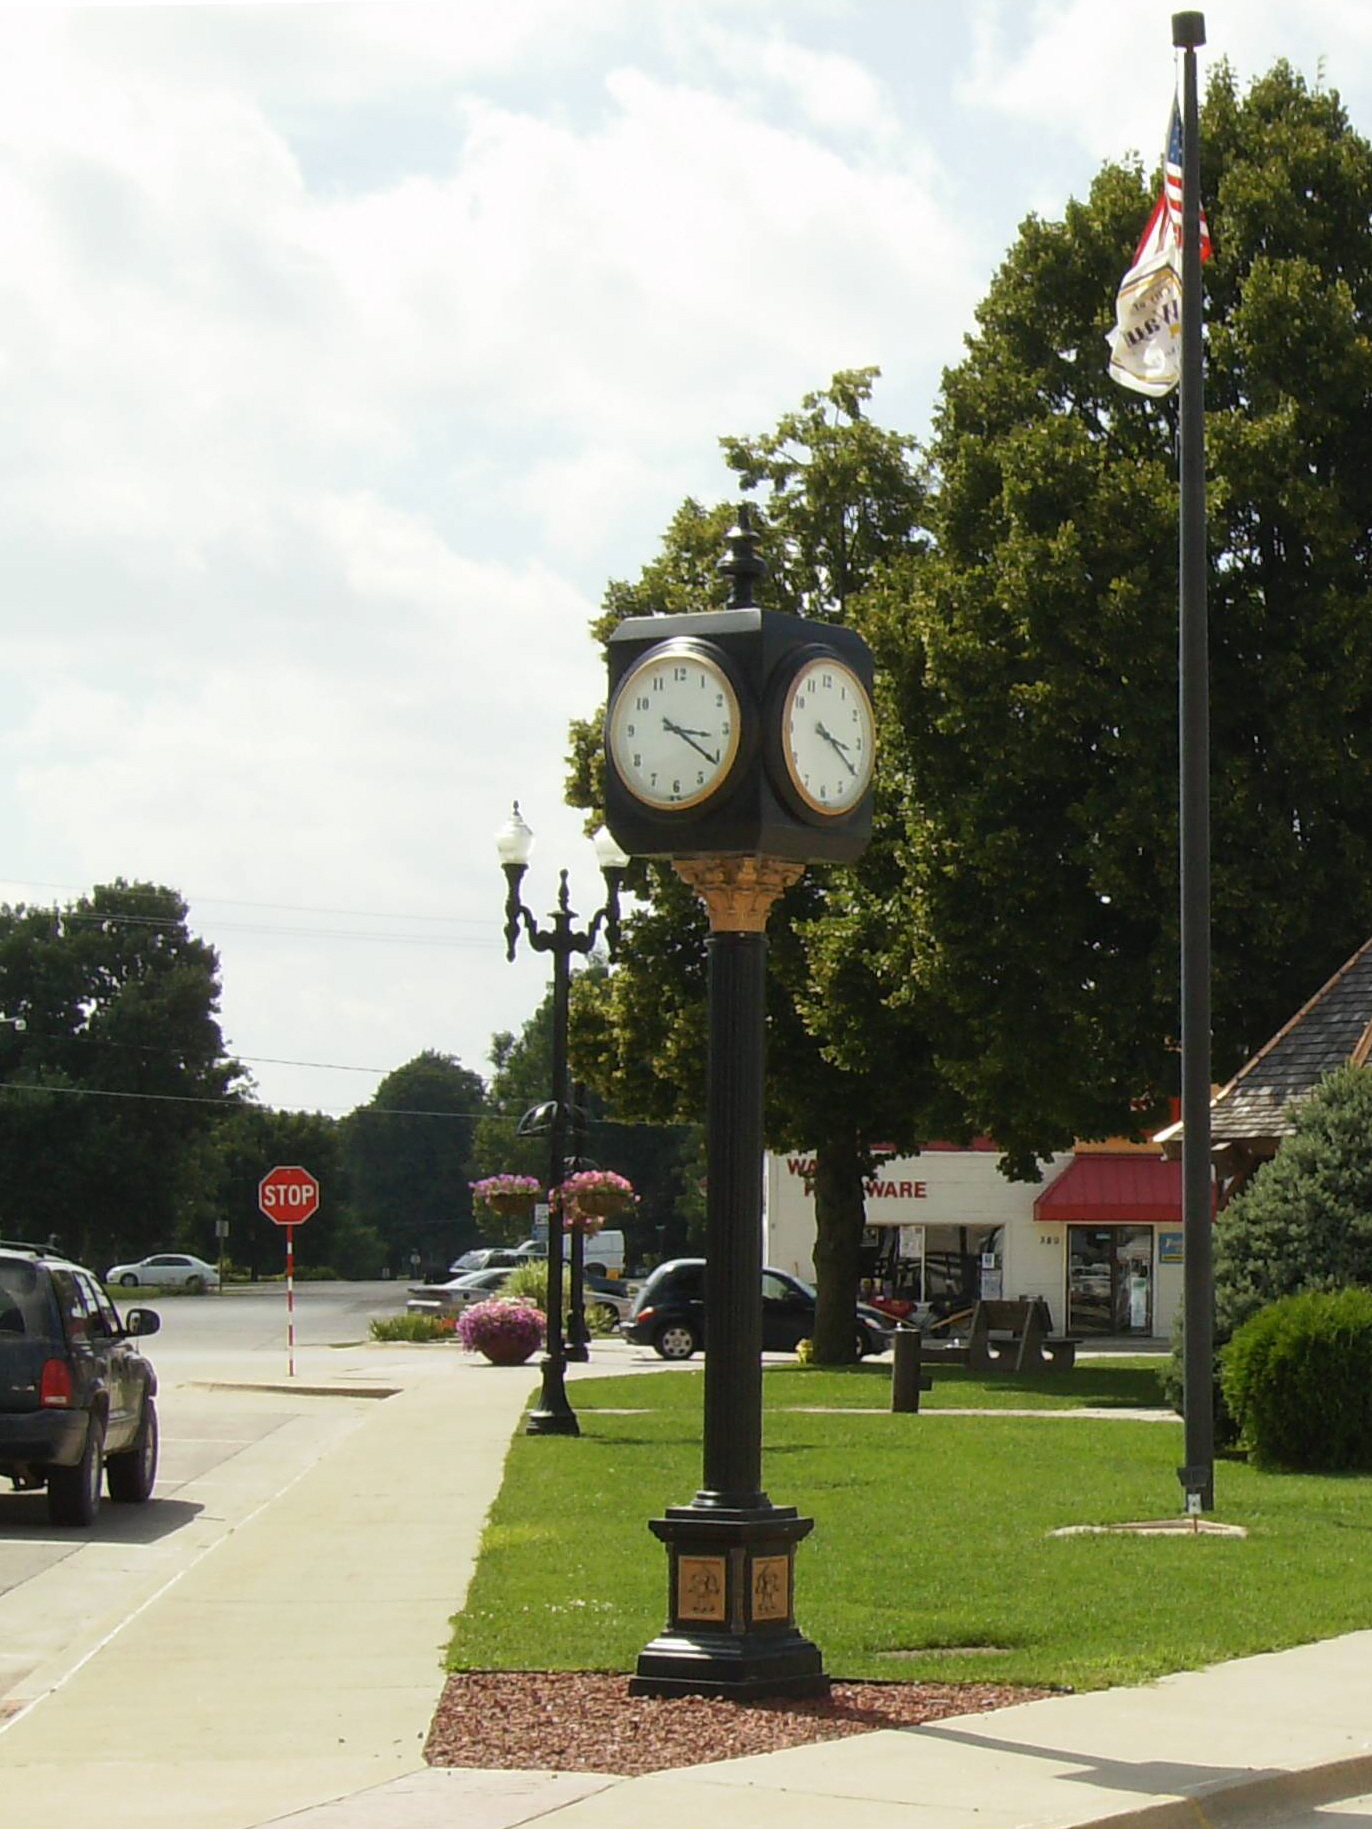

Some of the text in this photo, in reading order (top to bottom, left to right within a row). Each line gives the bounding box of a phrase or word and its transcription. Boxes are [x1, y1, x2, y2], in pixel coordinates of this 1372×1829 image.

[674, 668, 686, 681] 12
[823, 674, 832, 688] 12
[653, 677, 663, 691] 11
[701, 675, 705, 688] 1
[807, 679, 816, 693] 11
[636, 698, 649, 710] 10
[795, 695, 805, 709] 10
[627, 725, 634, 737] 9
[634, 754, 641, 767] 8
[651, 773, 657, 786] 7
[697, 771, 704, 784] 5
[673, 780, 680, 793] 6
[264, 1185, 314, 1207] STOP
